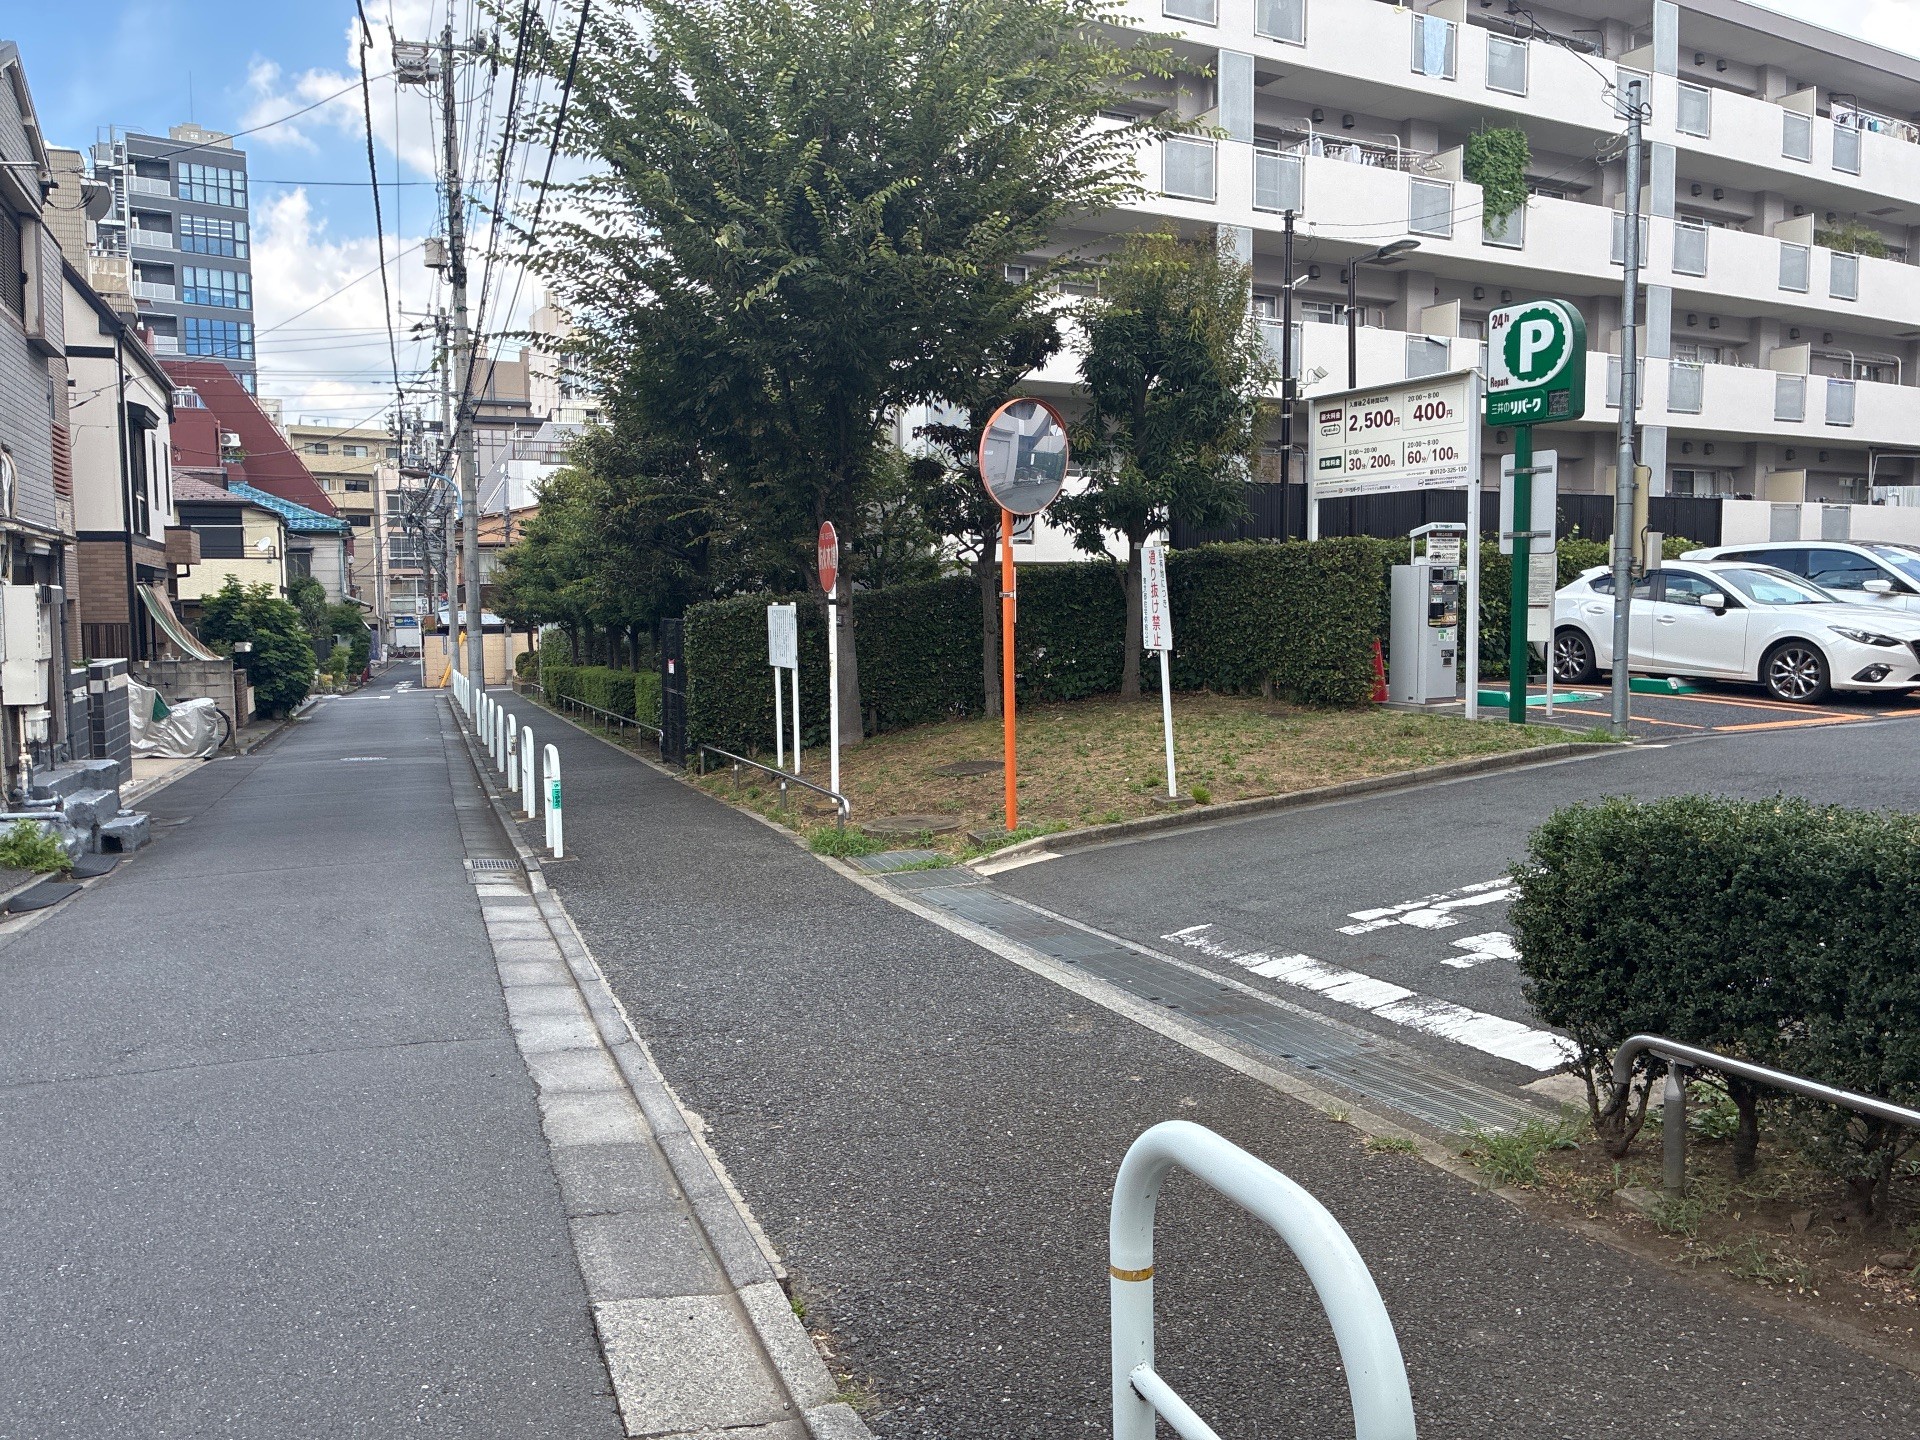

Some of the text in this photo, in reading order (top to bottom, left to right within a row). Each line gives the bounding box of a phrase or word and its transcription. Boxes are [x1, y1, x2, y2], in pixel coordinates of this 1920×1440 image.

[1492, 313, 1509, 330] 24h
[1519, 319, 1555, 374] P
[1490, 377, 1509, 388] Repark
[1413, 401, 1453, 422] 400円
[1491, 397, 1541, 415] 三井のリパーク
[1349, 409, 1400, 432] 2,500円
[1149, 550, 1162, 647] 通り抜け禁止
